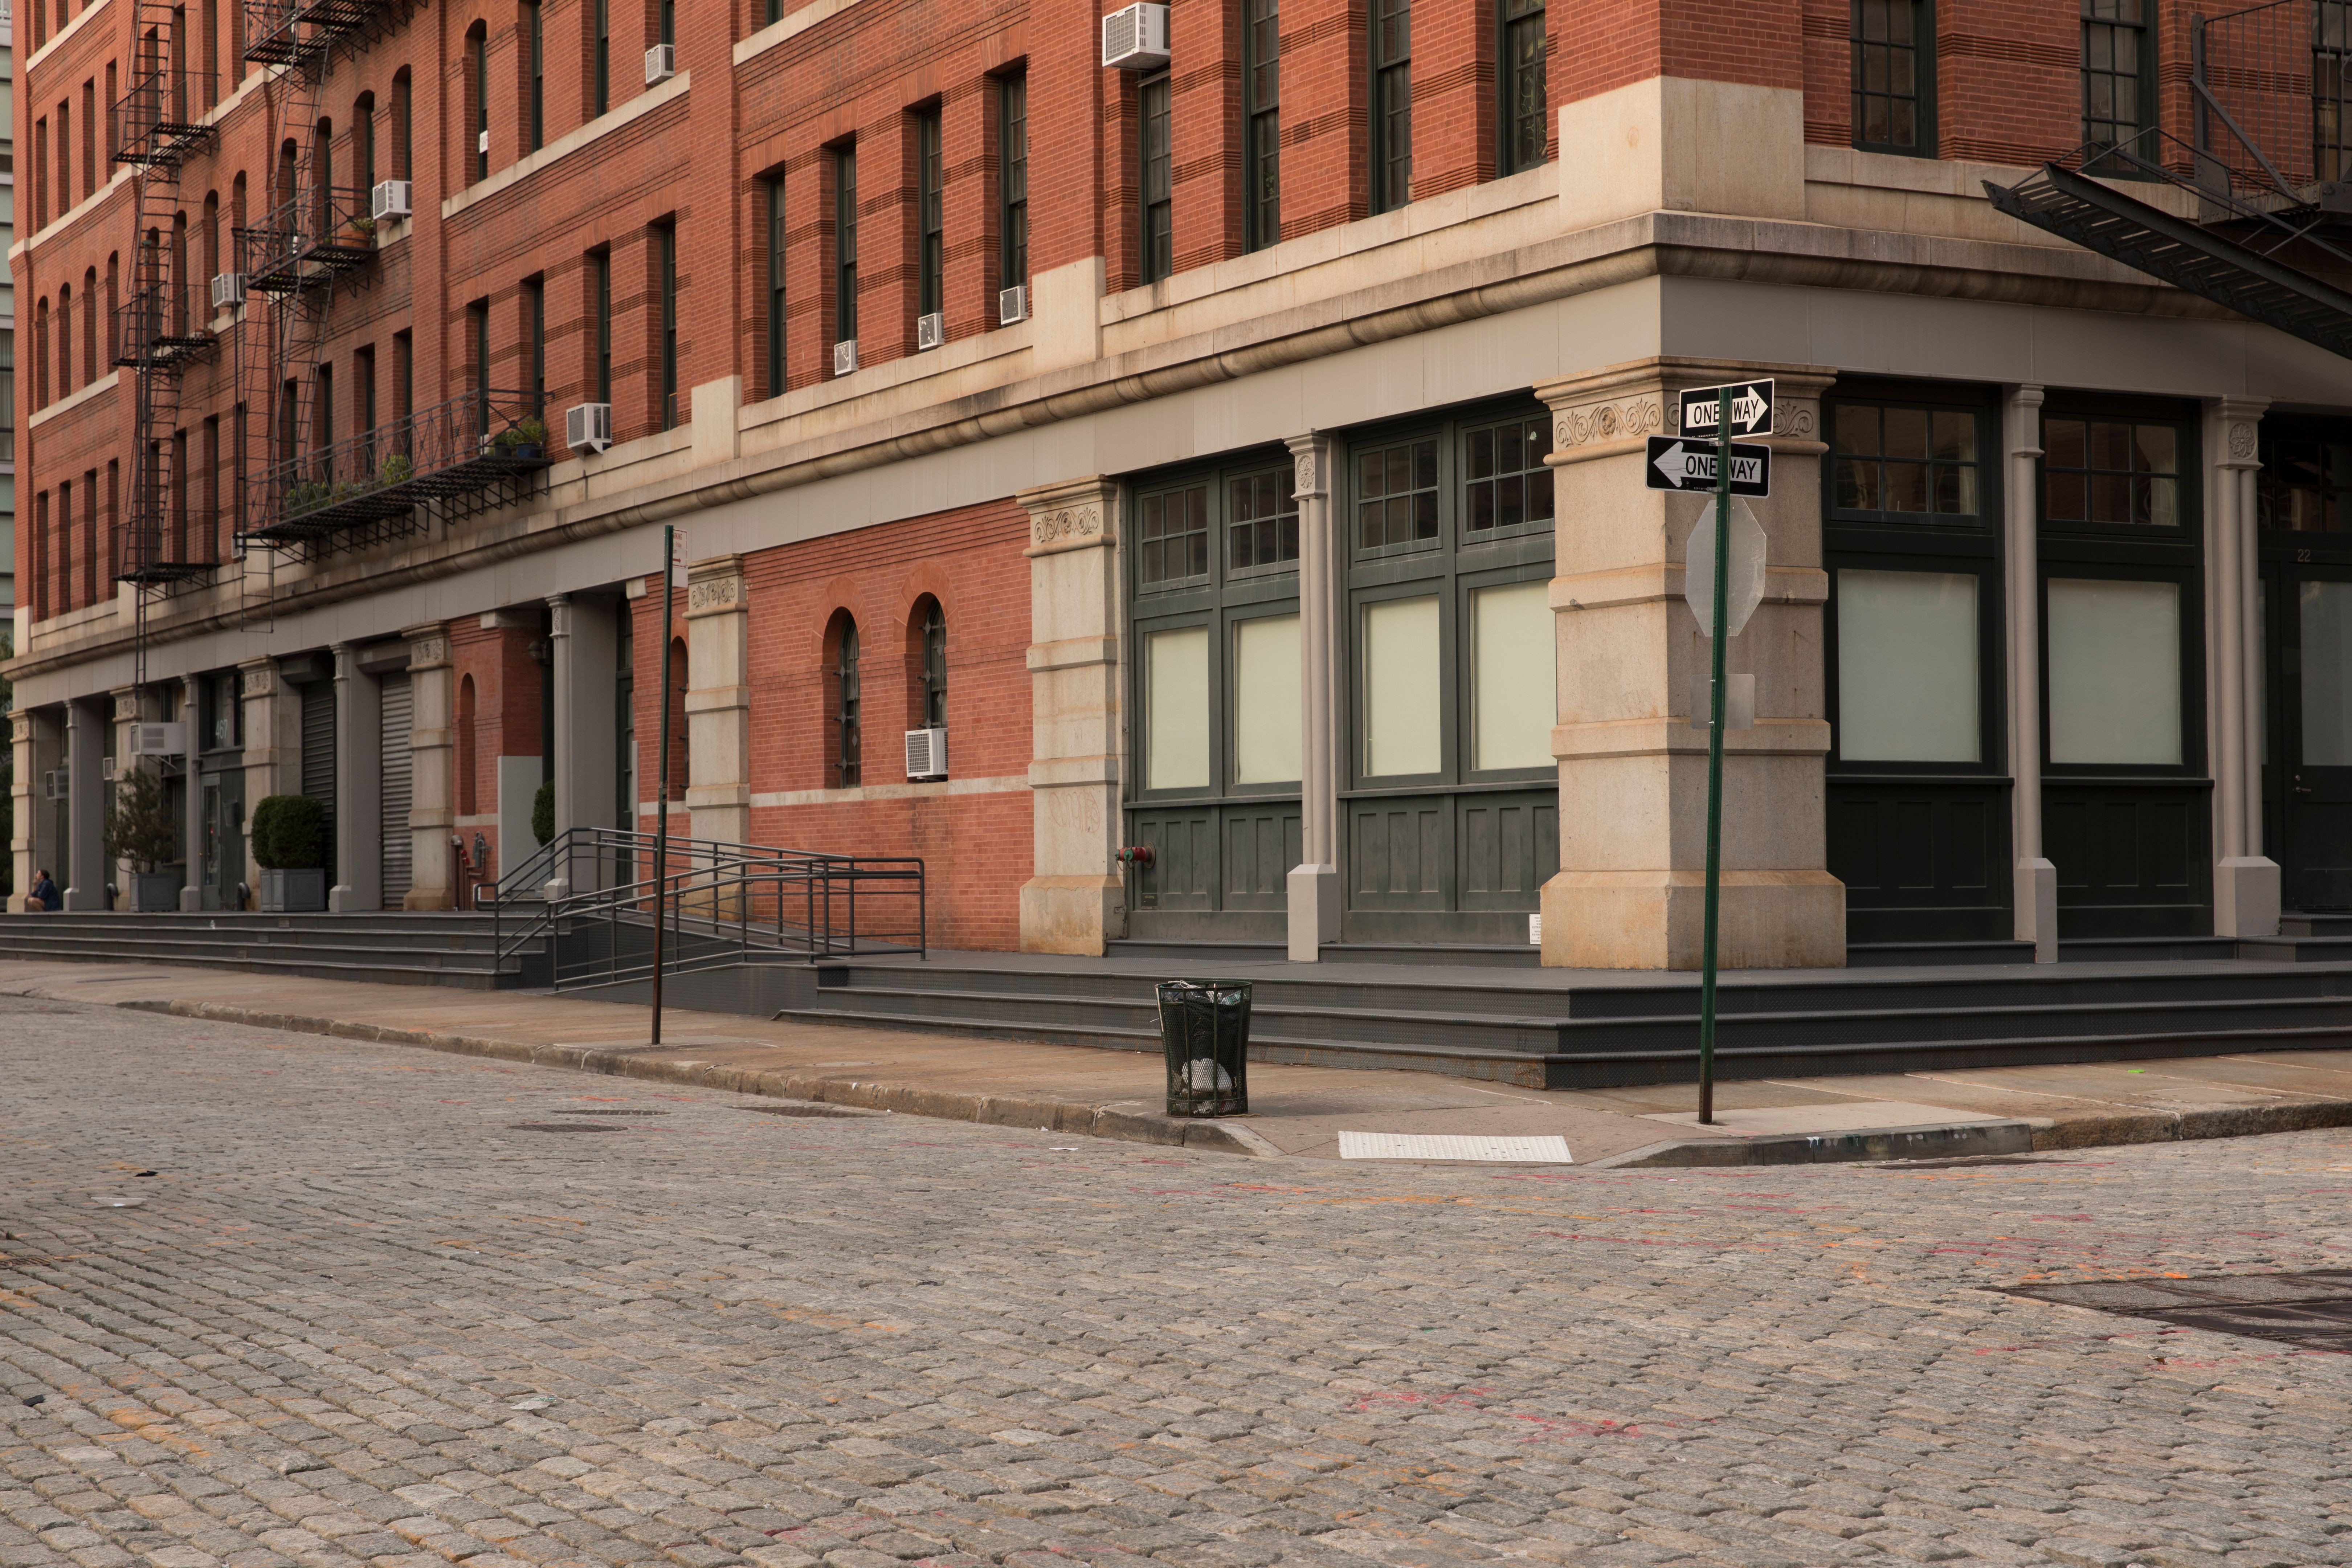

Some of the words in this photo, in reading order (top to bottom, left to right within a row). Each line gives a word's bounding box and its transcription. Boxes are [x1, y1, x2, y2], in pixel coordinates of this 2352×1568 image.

[1694, 404, 1719, 424] ONE
[1734, 399, 1759, 420] WAY
[1686, 455, 1718, 477] ONE
[2298, 549, 2311, 562] 22
[215, 719, 228, 740] 467
